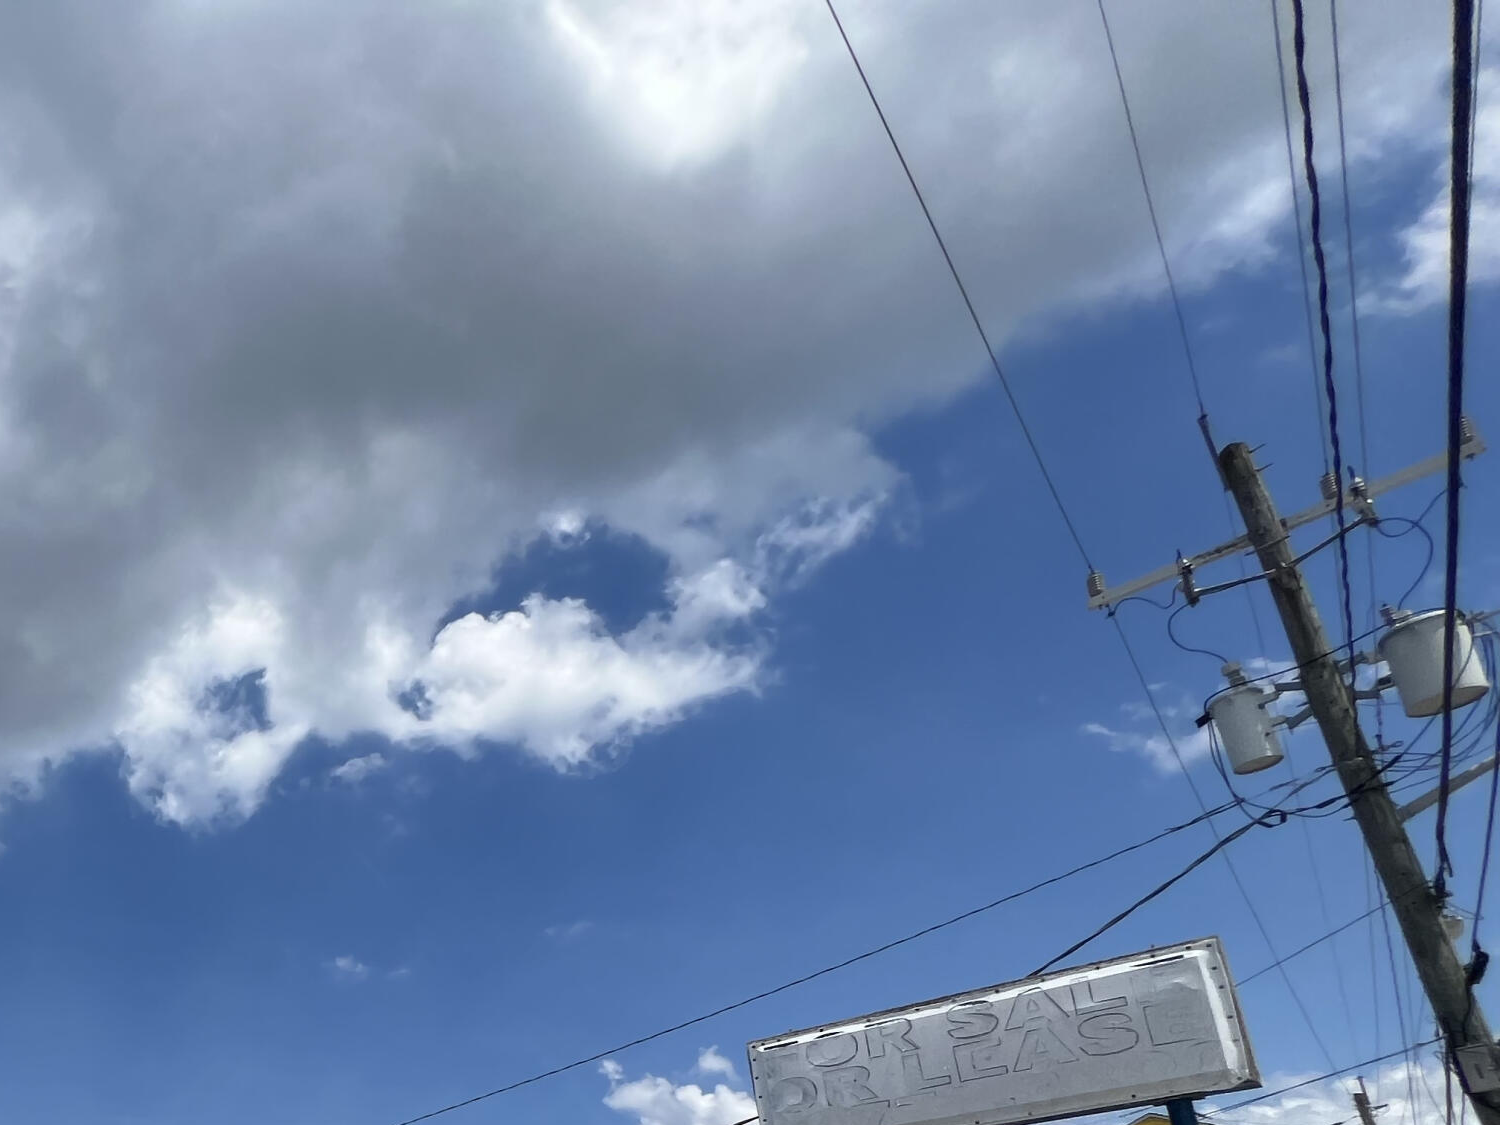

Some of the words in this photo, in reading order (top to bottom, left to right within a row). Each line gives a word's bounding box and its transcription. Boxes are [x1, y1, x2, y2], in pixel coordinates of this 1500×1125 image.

[768, 1016, 922, 1081] FOR
[769, 1063, 881, 1114] OR
[901, 998, 1212, 1092] LEASE
